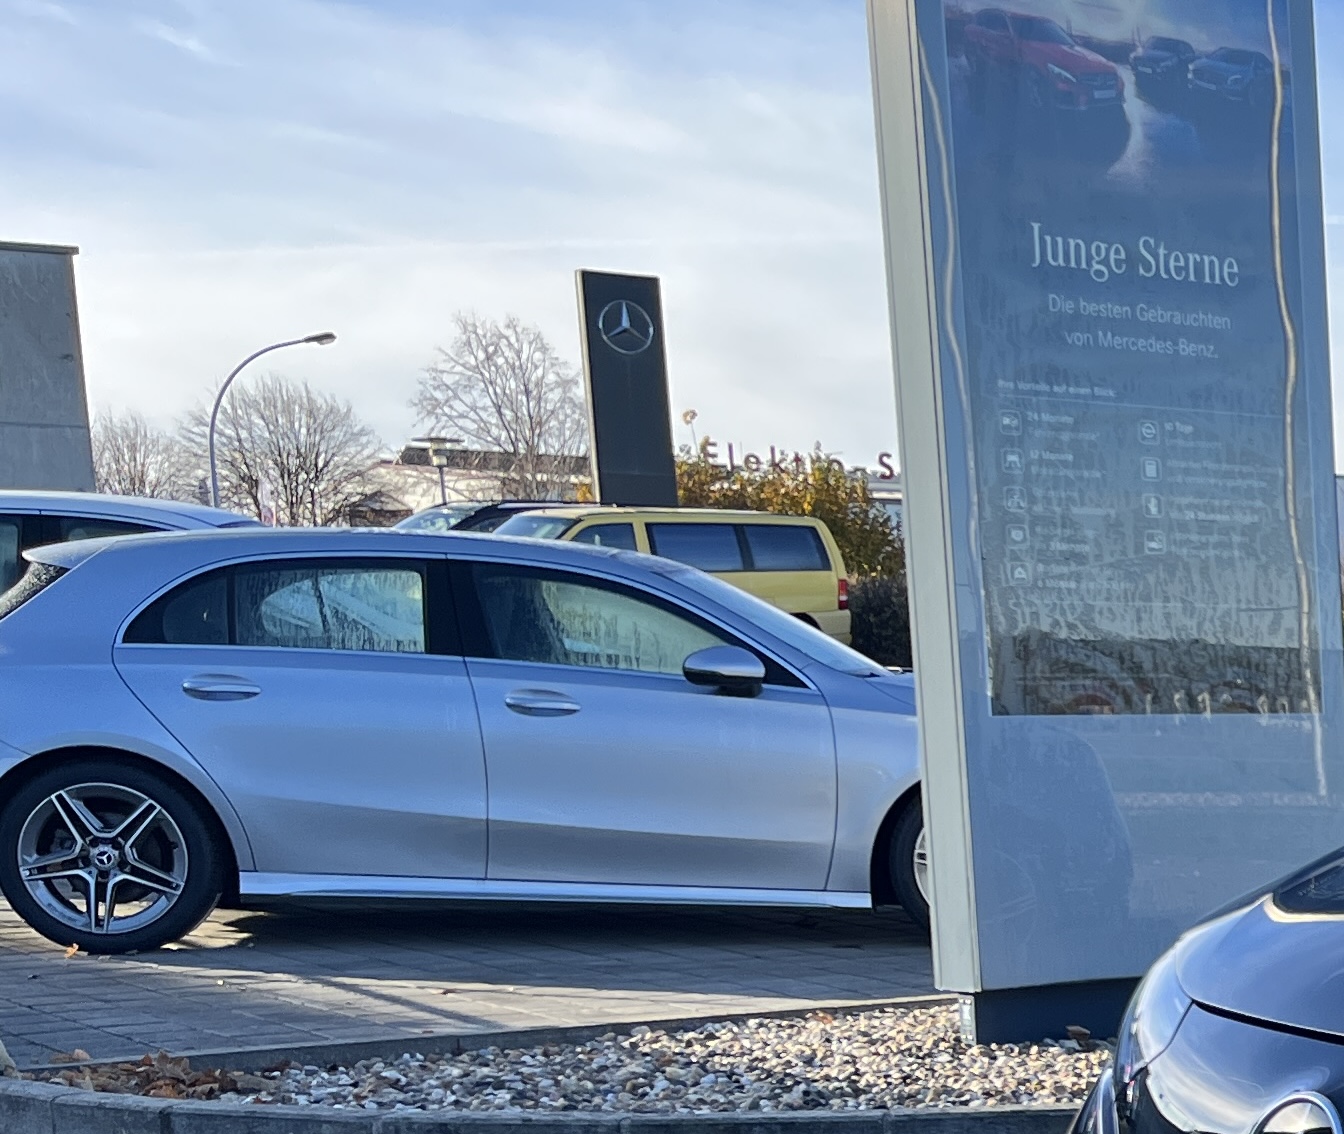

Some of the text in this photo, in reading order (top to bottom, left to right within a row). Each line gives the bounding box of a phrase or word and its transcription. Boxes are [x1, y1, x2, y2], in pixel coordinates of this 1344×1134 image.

[1030, 222, 1240, 287] Junge Sterne
[1048, 294, 1232, 330] Die besten Gebrauchten
[1064, 331, 1220, 359] von Mercedes-Benz.
